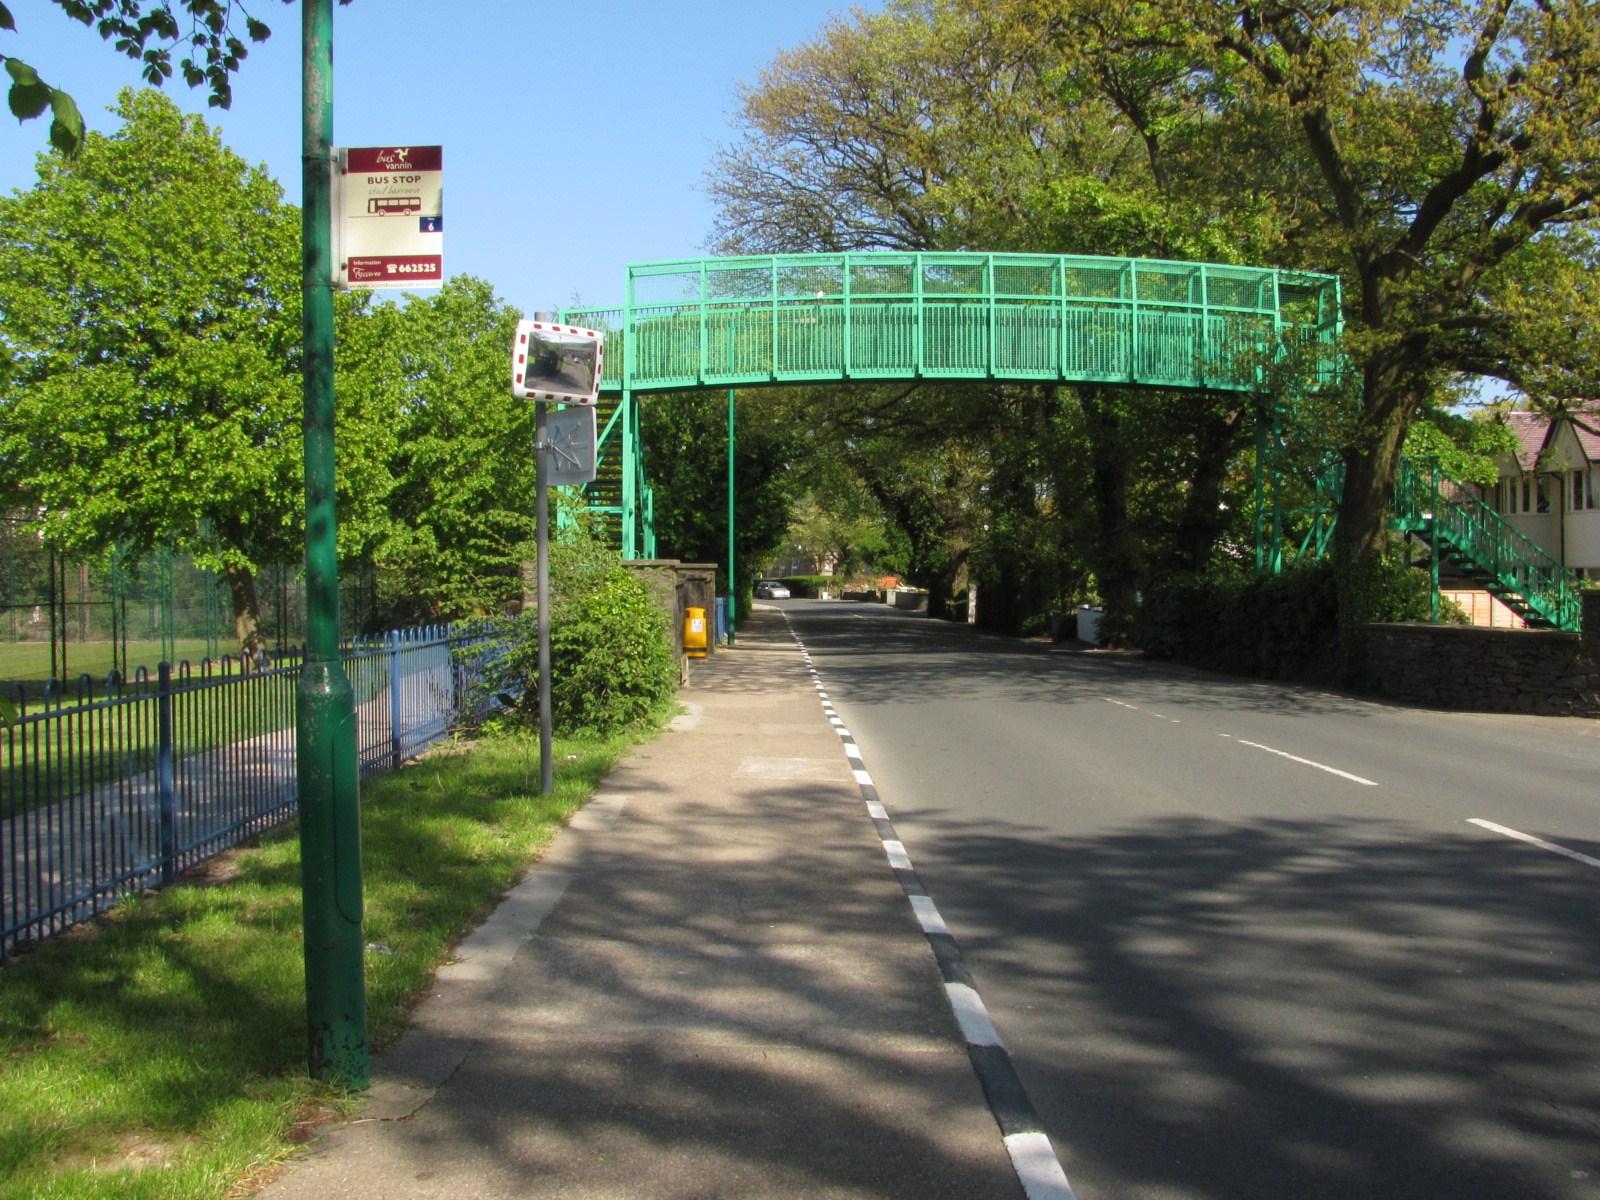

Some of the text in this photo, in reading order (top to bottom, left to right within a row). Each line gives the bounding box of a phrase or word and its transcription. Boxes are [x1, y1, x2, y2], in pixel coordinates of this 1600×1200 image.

[376, 151, 395, 163] bus
[386, 162, 412, 170] vannin
[368, 175, 422, 185] BUS STOP
[399, 263, 436, 272] 662525
